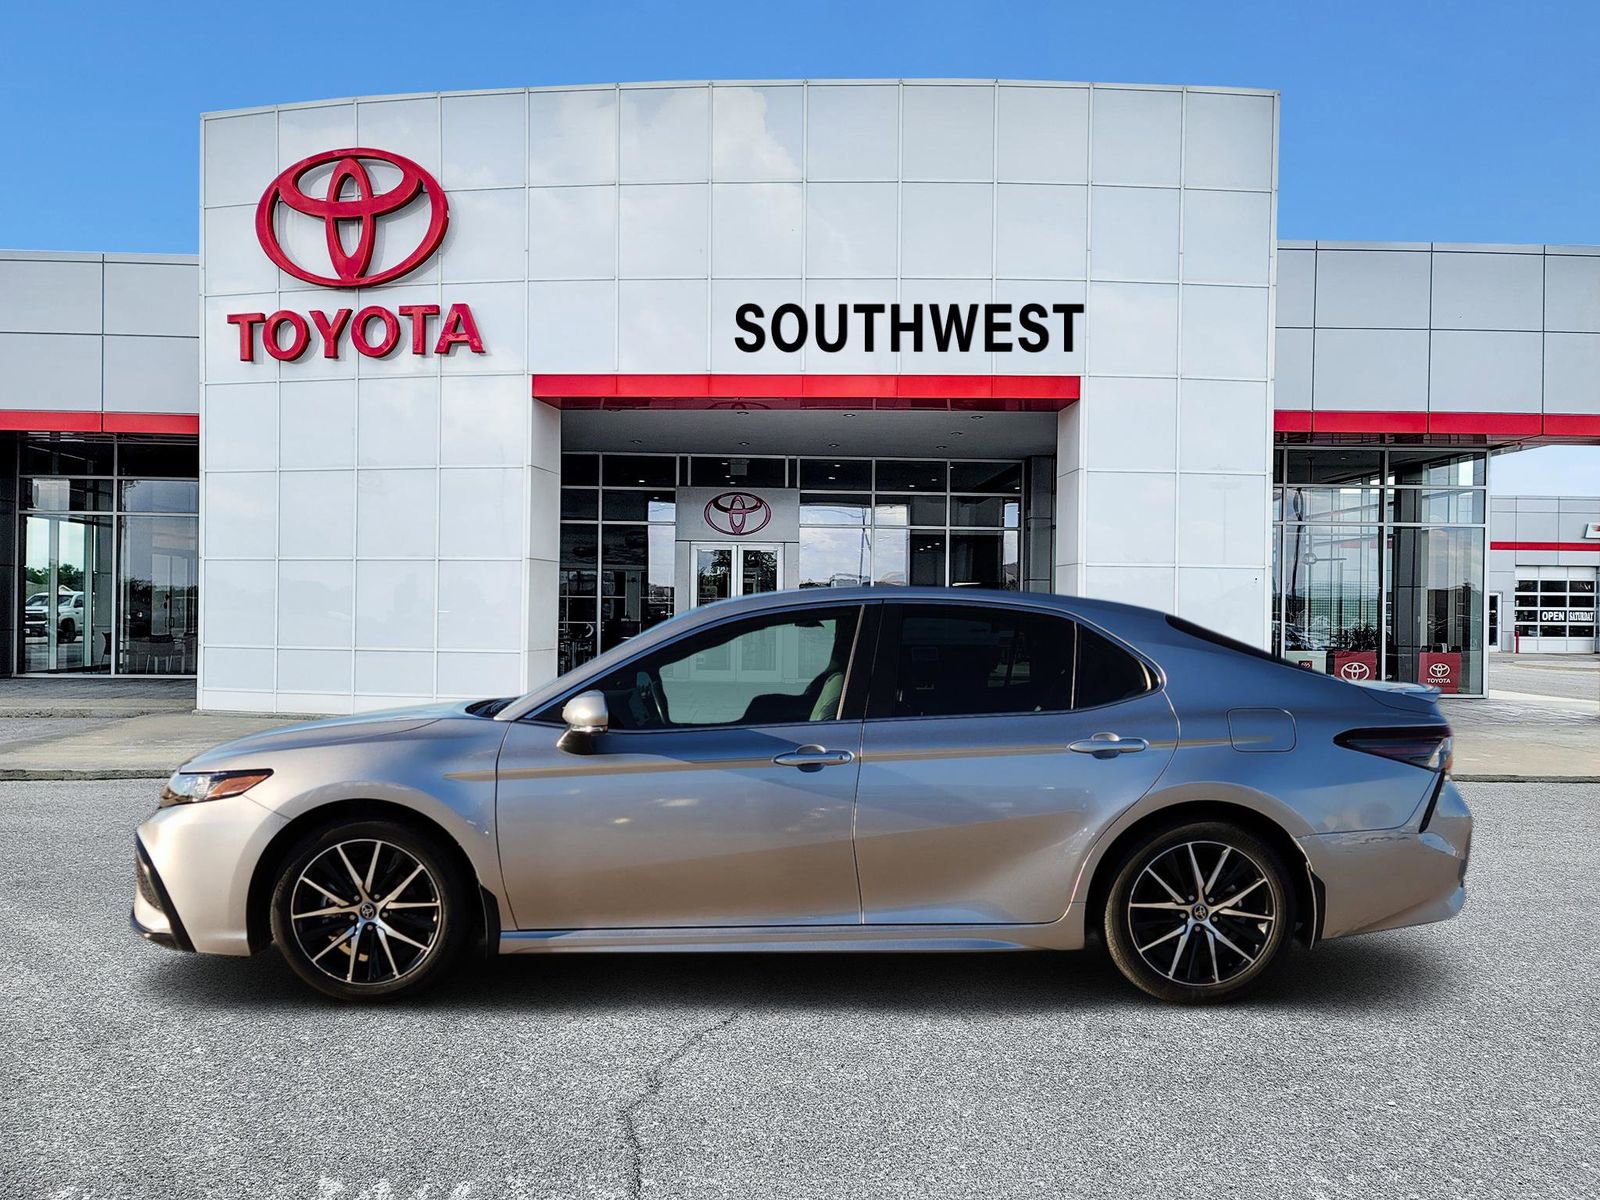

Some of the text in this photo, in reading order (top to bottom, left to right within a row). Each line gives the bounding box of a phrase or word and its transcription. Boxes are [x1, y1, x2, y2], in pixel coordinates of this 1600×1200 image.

[227, 303, 486, 362] TOYOTA
[734, 303, 1085, 353] SOUTHWEST
[1541, 611, 1594, 621] OPEN SATURDAY
